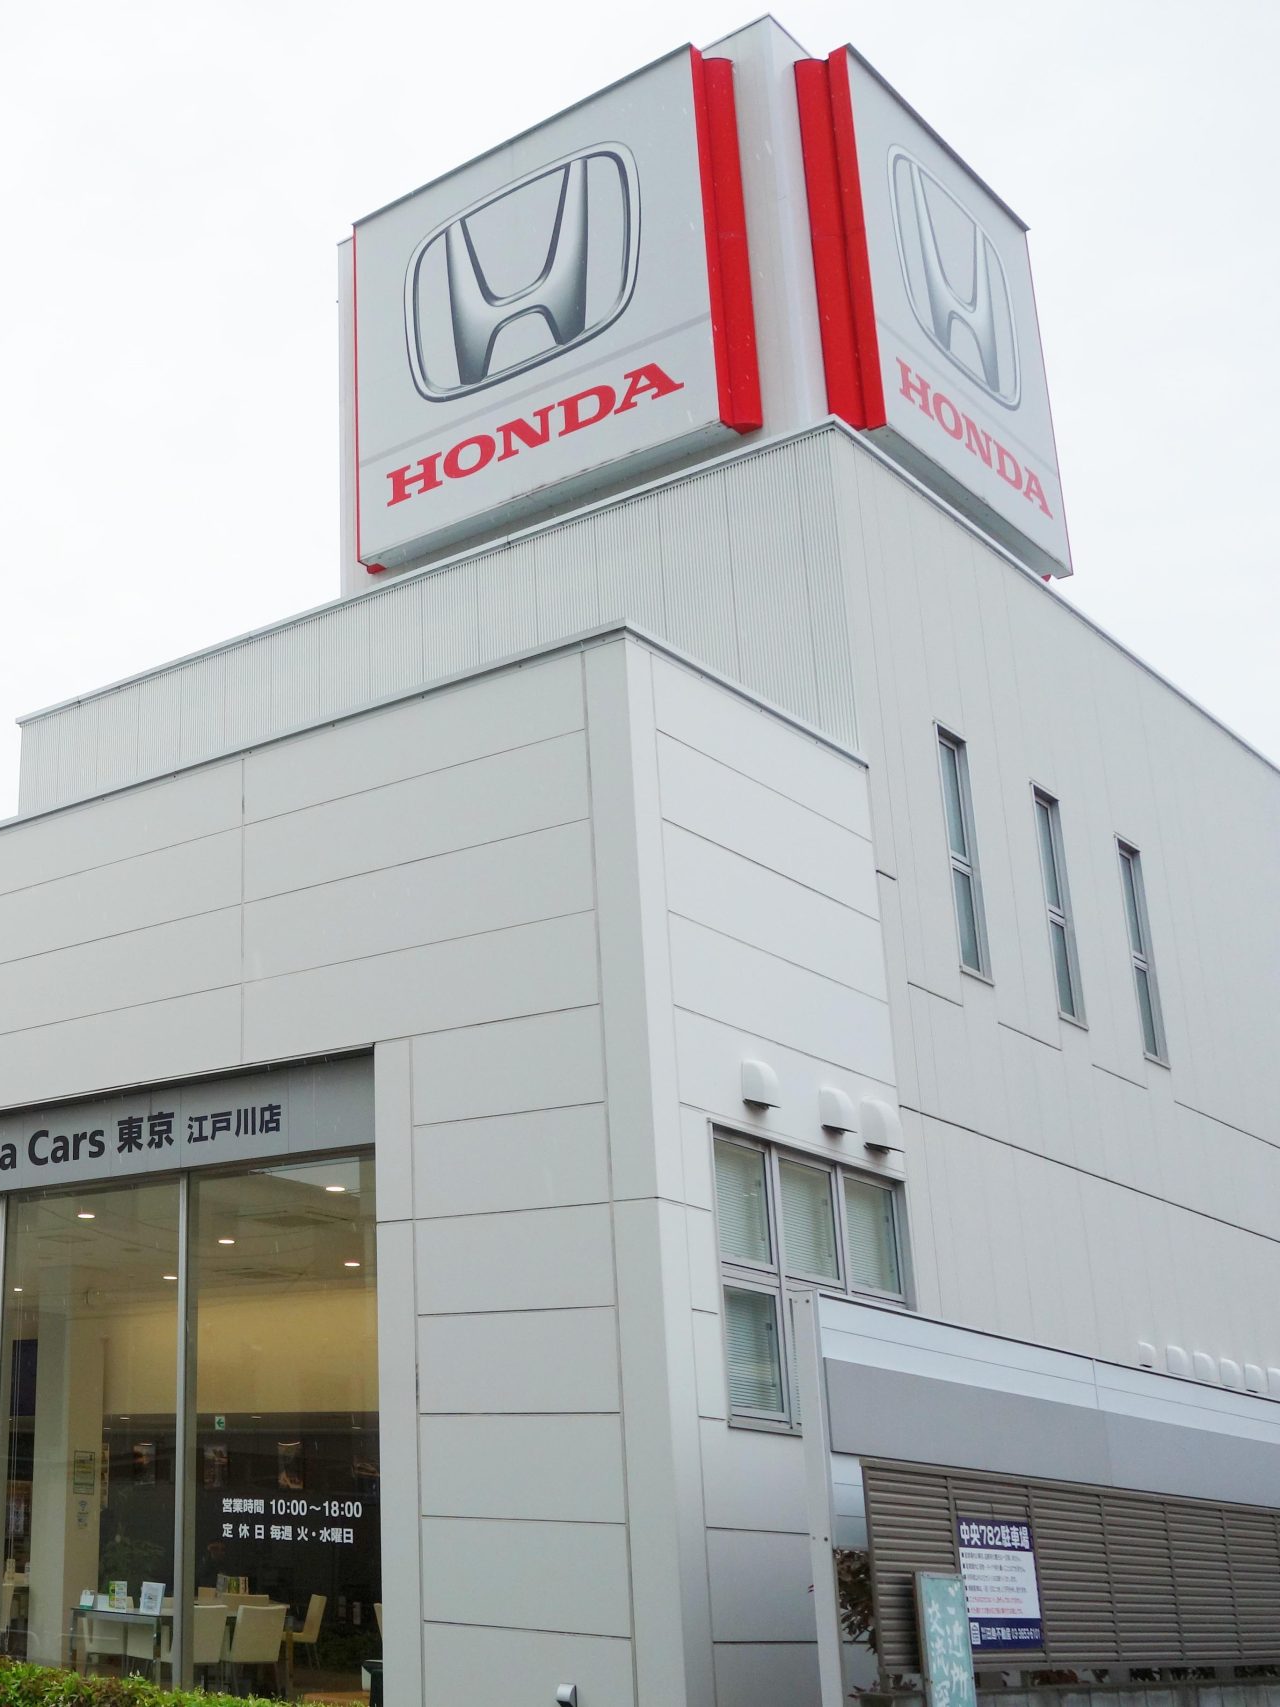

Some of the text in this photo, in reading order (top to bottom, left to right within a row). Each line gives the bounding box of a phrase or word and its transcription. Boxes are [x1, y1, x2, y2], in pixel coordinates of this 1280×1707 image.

[386, 362, 685, 507] HONDA
[895, 356, 1053, 519] HONDA
[27, 1128, 106, 1167] Cars
[116, 1111, 175, 1154] 東京
[187, 1103, 282, 1145] 江戸川店
[222, 1498, 265, 1514] 営業時間
[270, 1525, 293, 1541] 毎週
[297, 1526, 354, 1544] 火・水曜日
[959, 1521, 1030, 1549] 中央782駐車場
